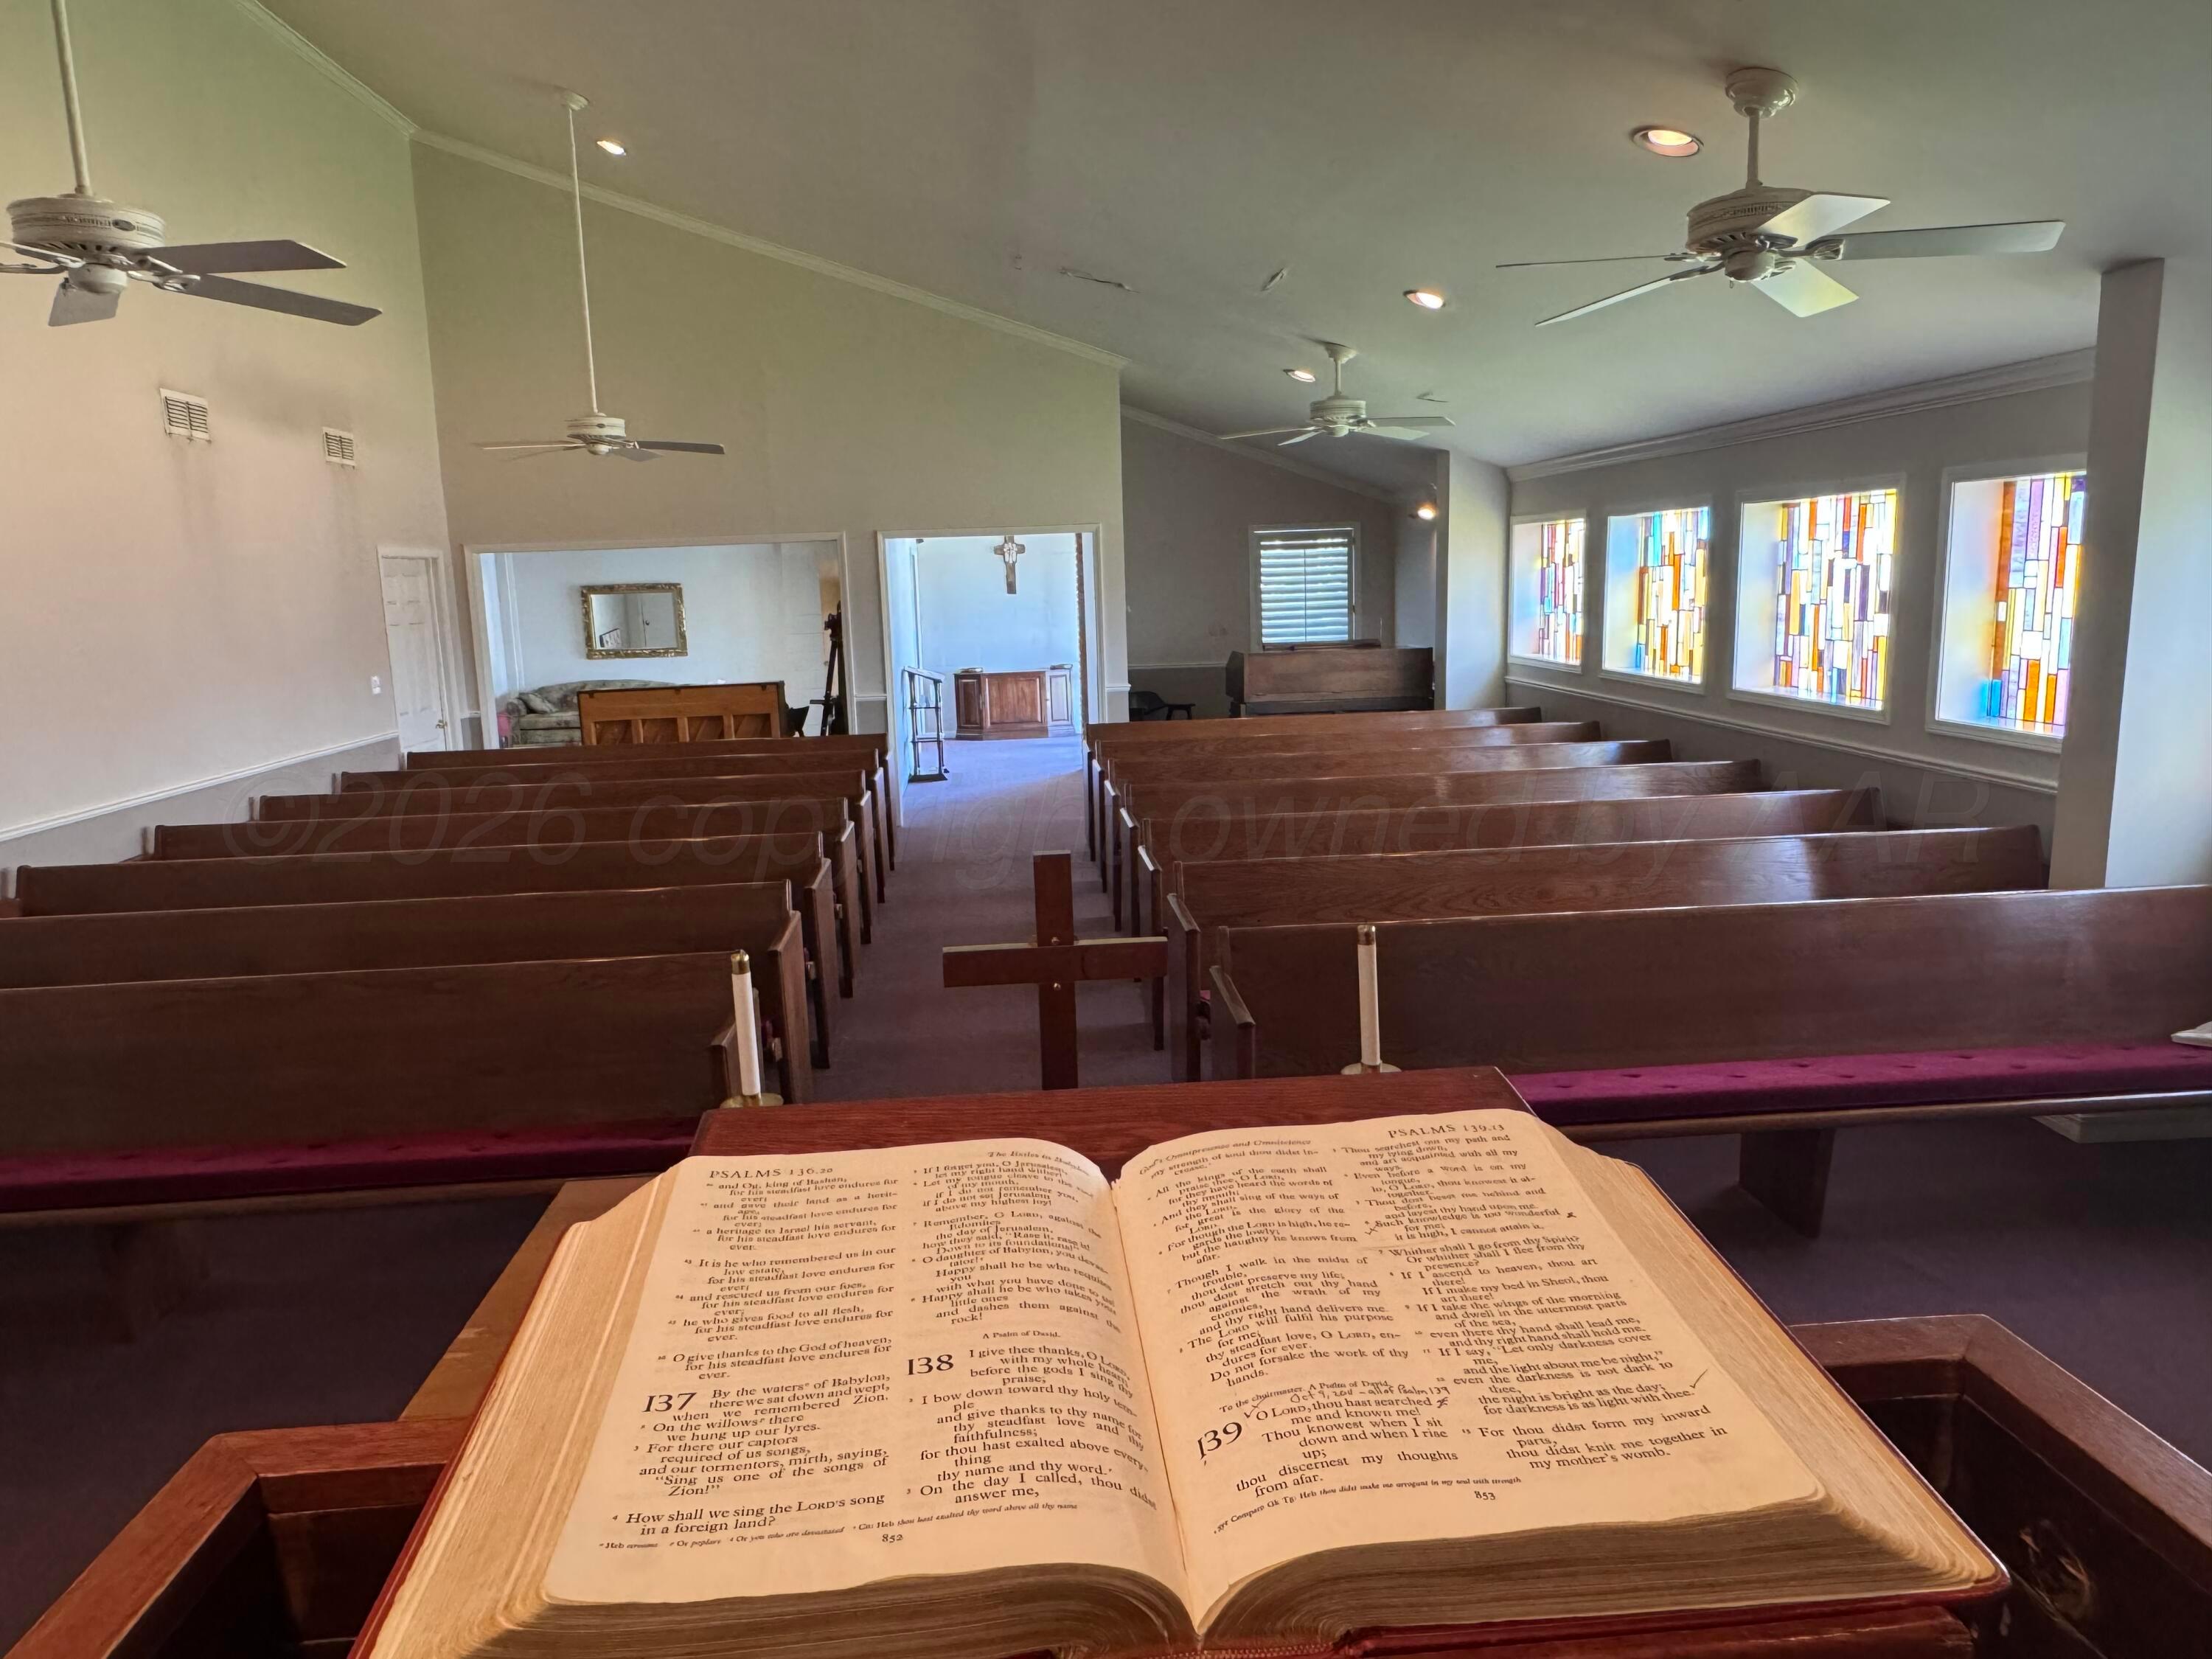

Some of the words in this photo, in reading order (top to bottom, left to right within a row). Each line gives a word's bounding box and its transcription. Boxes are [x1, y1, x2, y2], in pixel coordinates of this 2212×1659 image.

[1388, 1124, 1456, 1138] PSALMS
[709, 1169, 782, 1178] PSALMS
[1175, 1267, 1220, 1287] Though
[1225, 1263, 1231, 1271] I
[1239, 1256, 1267, 1268] walk
[1273, 1256, 1286, 1264] in
[1292, 1255, 1310, 1264] the
[1317, 1255, 1349, 1264] midst
[1356, 1255, 1368, 1264] of
[1400, 1270, 1412, 1279] If
[1419, 1270, 1425, 1279] I
[1432, 1267, 1472, 1278] ascend
[1547, 1260, 1575, 1269] thou
[1581, 1258, 1598, 1266] art
[908, 1354, 954, 1375] 138
[1211, 1371, 1231, 1380] Do
[1234, 1362, 1254, 1374] not
[1259, 1352, 1305, 1367] forsake
[1310, 1349, 1329, 1358] the
[1334, 1348, 1368, 1357] work
[1372, 1348, 1385, 1357] of
[1388, 1348, 1408, 1361] thy
[970, 1366, 1010, 1376] before
[1017, 1364, 1038, 1374] the
[1043, 1364, 1073, 1377] gods
[1079, 1366, 1084, 1375] I
[1090, 1370, 1113, 1386] sing
[1118, 1380, 1133, 1397] thy
[641, 1392, 697, 1413] 137
[709, 1398, 744, 1408] there
[766, 1393, 784, 1403] sat
[787, 1391, 824, 1400] down
[827, 1385, 852, 1396] and
[854, 1382, 889, 1395] wept,
[922, 1394, 928, 1404] I
[933, 1393, 961, 1402] bow
[966, 1388, 1003, 1399] down
[1008, 1383, 1054, 1394] toward
[1057, 1385, 1078, 1398] thy
[1083, 1387, 1110, 1402] holy
[1290, 1391, 1314, 1402] Oct
[1398, 1384, 1427, 1394] Psalm
[1431, 1386, 1450, 1395] 139
[672, 1411, 709, 1420] when
[754, 1397, 839, 1415] remembered
[852, 1394, 888, 1405] Zion.
[1290, 1416, 1312, 1424] me
[1315, 1411, 1342, 1422] and
[1346, 1409, 1392, 1419] known
[1395, 1407, 1421, 1416] me!
[1261, 1429, 1301, 1442] Thou
[1307, 1419, 1364, 1434] knowest
[1368, 1417, 1408, 1428] when
[1414, 1416, 1421, 1427] I
[1426, 1416, 1443, 1427] sit
[1480, 1427, 1504, 1436] For
[1512, 1426, 1545, 1436] thou
[1551, 1423, 1586, 1433] didst
[1592, 1420, 1627, 1430] form
[1632, 1416, 1653, 1426] my
[1660, 1405, 1711, 1420] inward
[920, 1450, 940, 1459] for
[945, 1447, 976, 1457] thou
[983, 1441, 1010, 1452] hast
[1015, 1438, 1065, 1448] exalted
[1069, 1440, 1109, 1453] above
[1197, 1422, 1242, 1459] 139
[1298, 1436, 1338, 1447] down
[1341, 1429, 1368, 1441] and
[1369, 1428, 1408, 1439] when
[1413, 1427, 1419, 1438] I
[1422, 1427, 1448, 1438] rise
[1506, 1447, 1540, 1457] thou
[1545, 1444, 1581, 1455] didst
[1585, 1441, 1616, 1452] knit
[1620, 1441, 1644, 1449] me
[1648, 1431, 1705, 1447] together
[1711, 1427, 1728, 1436] in
[639, 1465, 667, 1475] and
[701, 1460, 784, 1472] tormentors,
[788, 1453, 832, 1465] mirth,
[837, 1449, 888, 1462] saying,
[733, 1472, 759, 1481] one
[768, 1468, 782, 1478] of
[792, 1466, 814, 1475] the
[823, 1461, 863, 1472] songs
[873, 1455, 886, 1466] of
[1528, 1459, 1551, 1470] my
[1555, 1452, 1618, 1466] mother's
[1621, 1447, 1671, 1461] womb.
[937, 1469, 960, 1483] thy
[964, 1466, 1004, 1477] name
[1009, 1460, 1035, 1472] and
[1040, 1460, 1062, 1474] thy
[1236, 1475, 1267, 1491] thou
[1279, 1455, 1349, 1475] discernest
[1360, 1454, 1382, 1466] my
[1397, 1450, 1458, 1464] thoughts
[919, 1484, 942, 1495] On
[953, 1481, 974, 1492] the
[984, 1477, 1009, 1489] day
[1019, 1472, 1026, 1484] I
[1035, 1472, 1082, 1486] called,
[1091, 1476, 1122, 1489] thou
[1255, 1483, 1288, 1496] from
[1293, 1475, 1323, 1487] afar.
[1475, 1490, 1496, 1500] 853
[955, 1491, 1006, 1502] answer
[1012, 1489, 1039, 1498] me,
[625, 1513, 664, 1523] How
[667, 1509, 703, 1521] shall
[709, 1510, 730, 1518] we
[732, 1505, 765, 1518] sing
[769, 1502, 793, 1514] the
[849, 1495, 885, 1507] song
[640, 1524, 655, 1535] in
[674, 1520, 728, 1534] foreign
[733, 1515, 776, 1529] land?
[882, 1534, 903, 1543] 852
